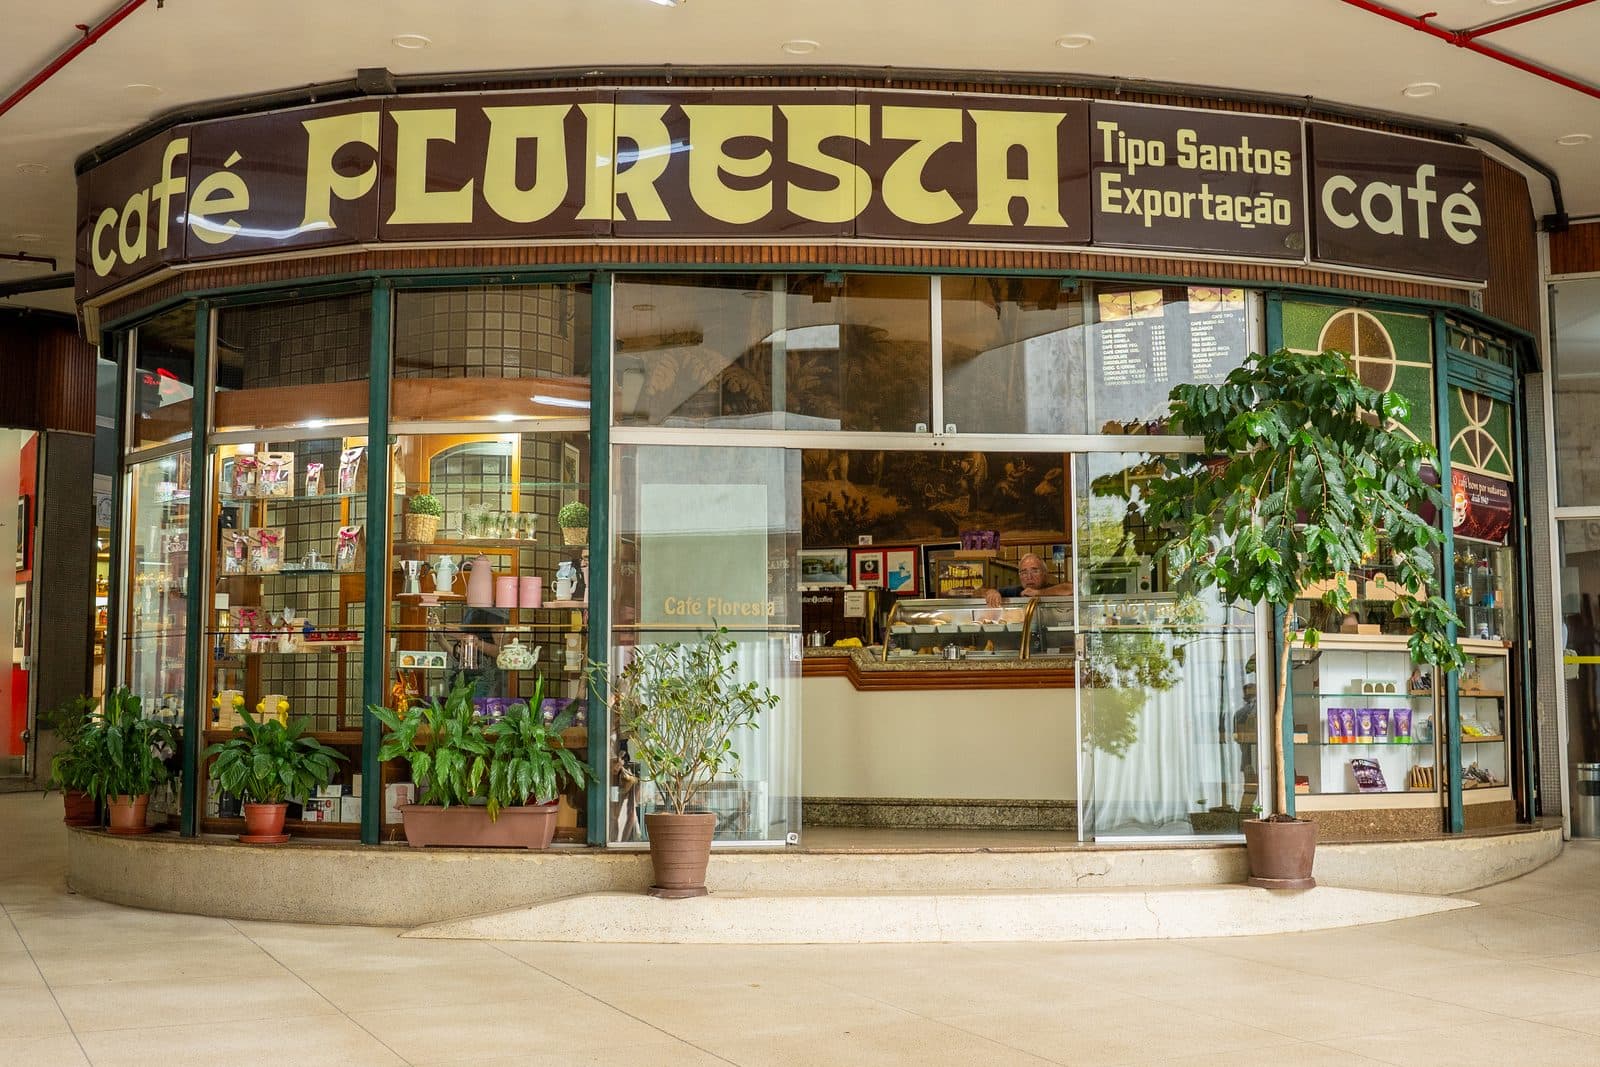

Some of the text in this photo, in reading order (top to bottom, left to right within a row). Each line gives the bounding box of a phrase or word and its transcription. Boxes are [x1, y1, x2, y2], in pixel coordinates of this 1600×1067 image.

[1096, 120, 1293, 177] Tipo Santos
[91, 102, 1067, 277] café FLORESTA
[1099, 172, 1293, 230] Exportação
[1321, 164, 1482, 246] café
[664, 596, 702, 616] Café
[706, 598, 775, 617] Floresta
